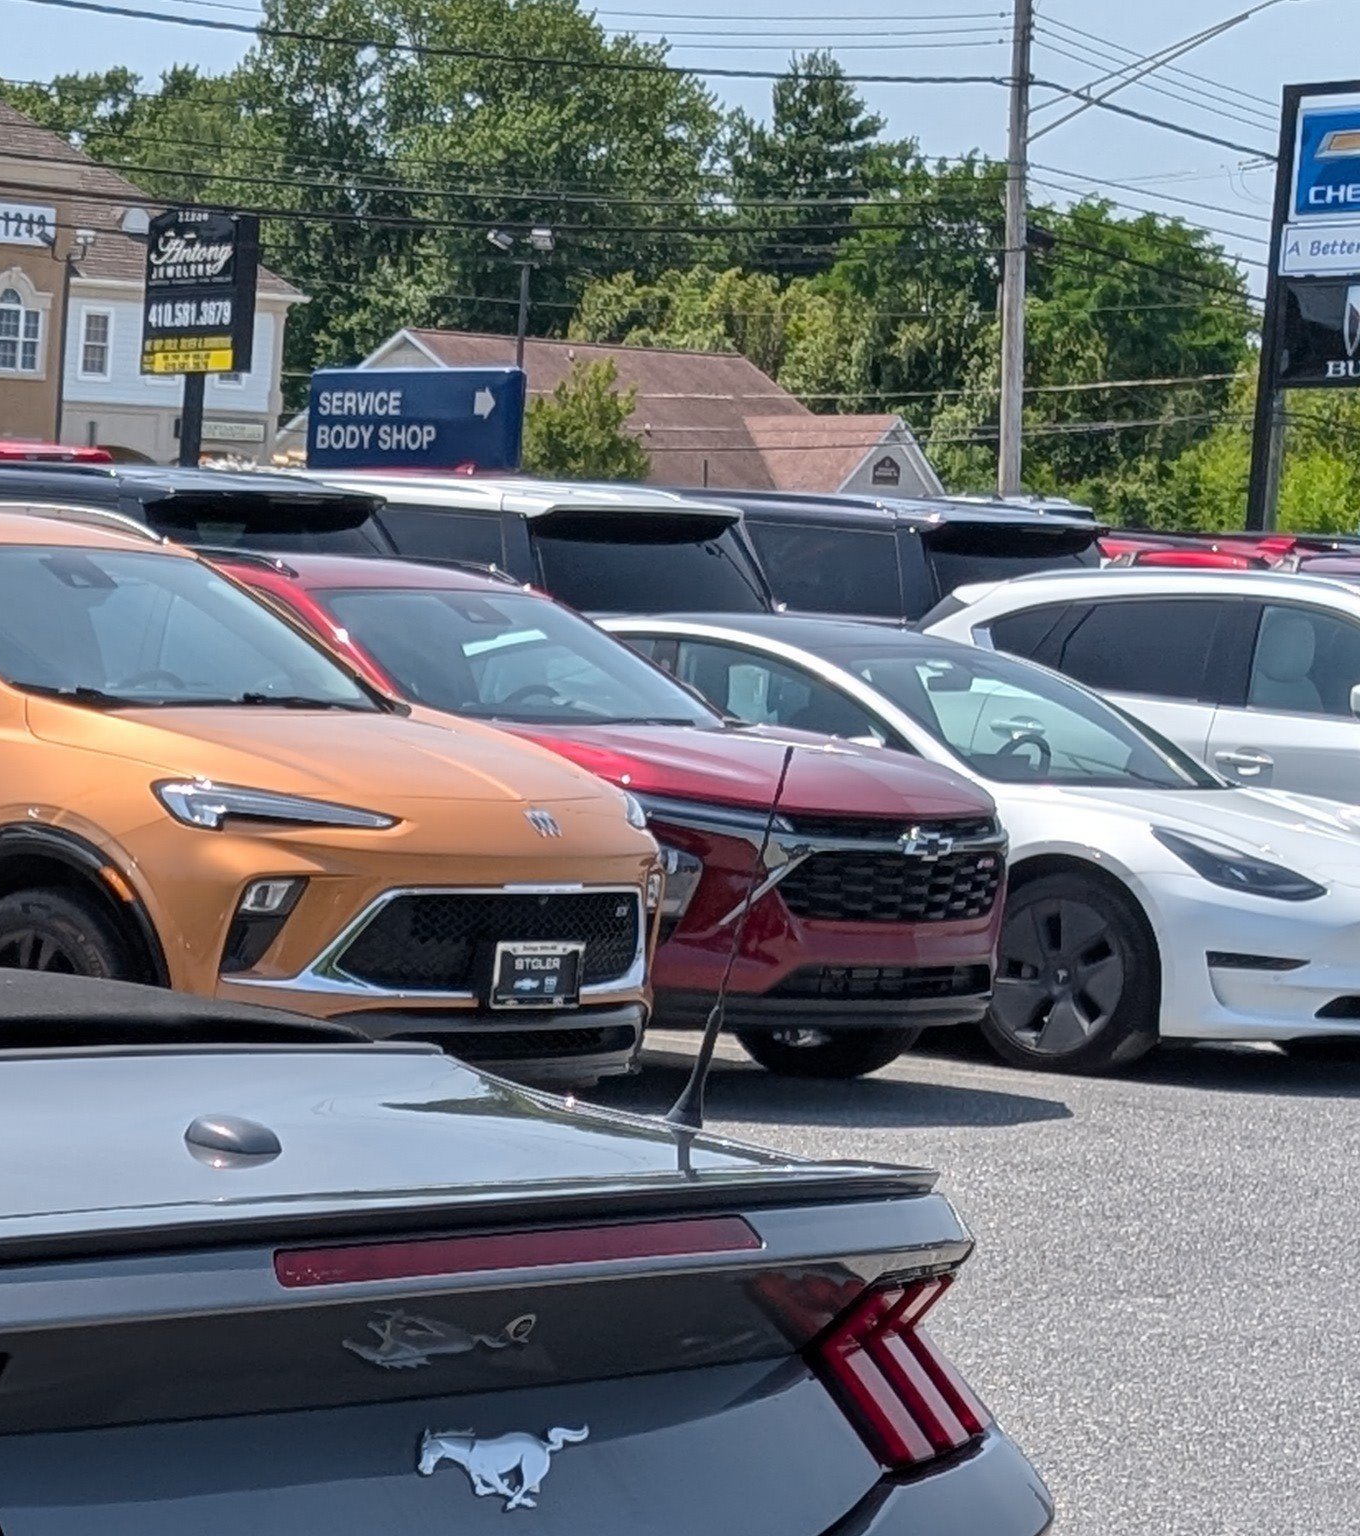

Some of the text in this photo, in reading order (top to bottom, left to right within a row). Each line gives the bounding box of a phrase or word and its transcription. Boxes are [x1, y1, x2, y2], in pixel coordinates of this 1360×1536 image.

[149, 229, 234, 275] Antony
[1288, 241, 1301, 256] A
[318, 391, 402, 416] SERVICE
[315, 424, 436, 451] BODY SHOP
[514, 957, 561, 971] STOLER
